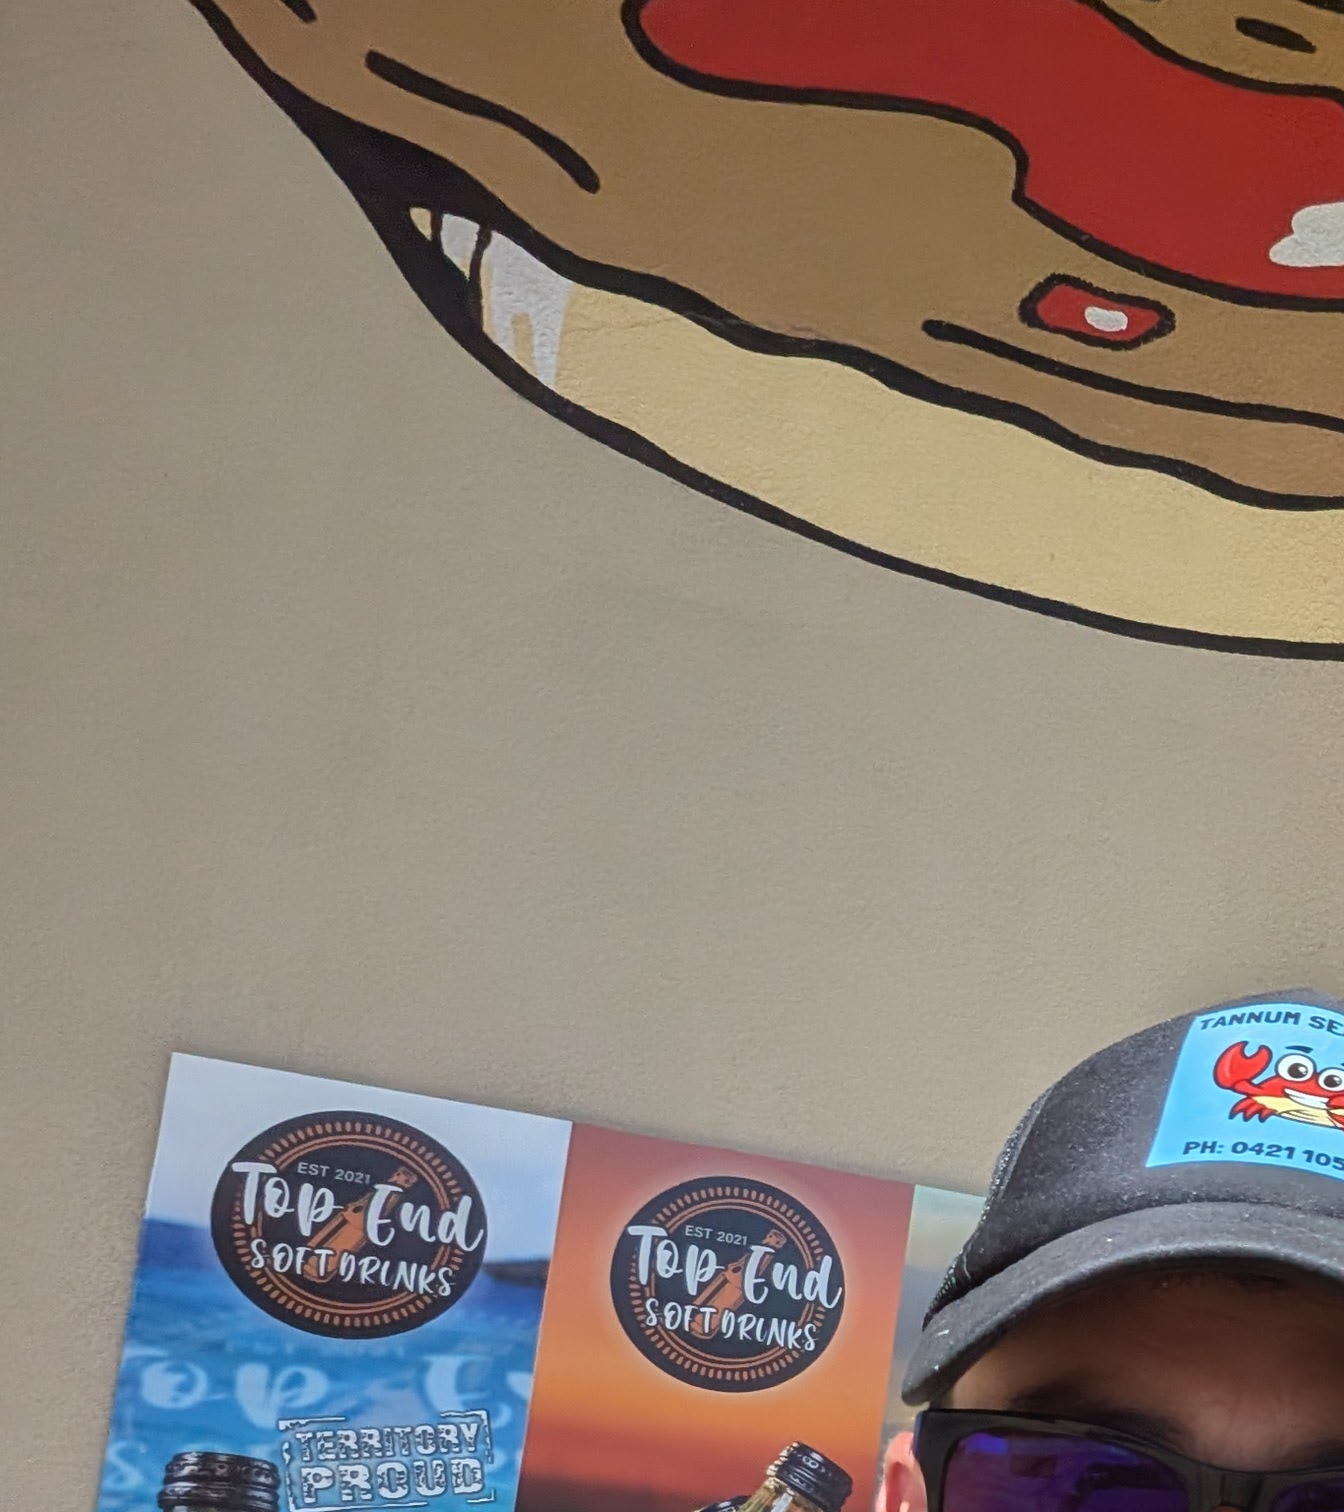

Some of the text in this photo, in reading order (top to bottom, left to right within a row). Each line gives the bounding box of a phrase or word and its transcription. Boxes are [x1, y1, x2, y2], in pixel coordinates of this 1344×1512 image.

[1200, 1011, 1300, 1031] TANNUM
[1182, 1140, 1224, 1155] PH:
[1231, 1141, 1294, 1160] 0421
[297, 1161, 371, 1184] EST 2021
[231, 1162, 485, 1252] Top End
[685, 1225, 748, 1246] EST 2021
[628, 1225, 843, 1309] Top End
[295, 1422, 480, 1462] TERRITORY
[301, 1458, 485, 1504] PROUD
